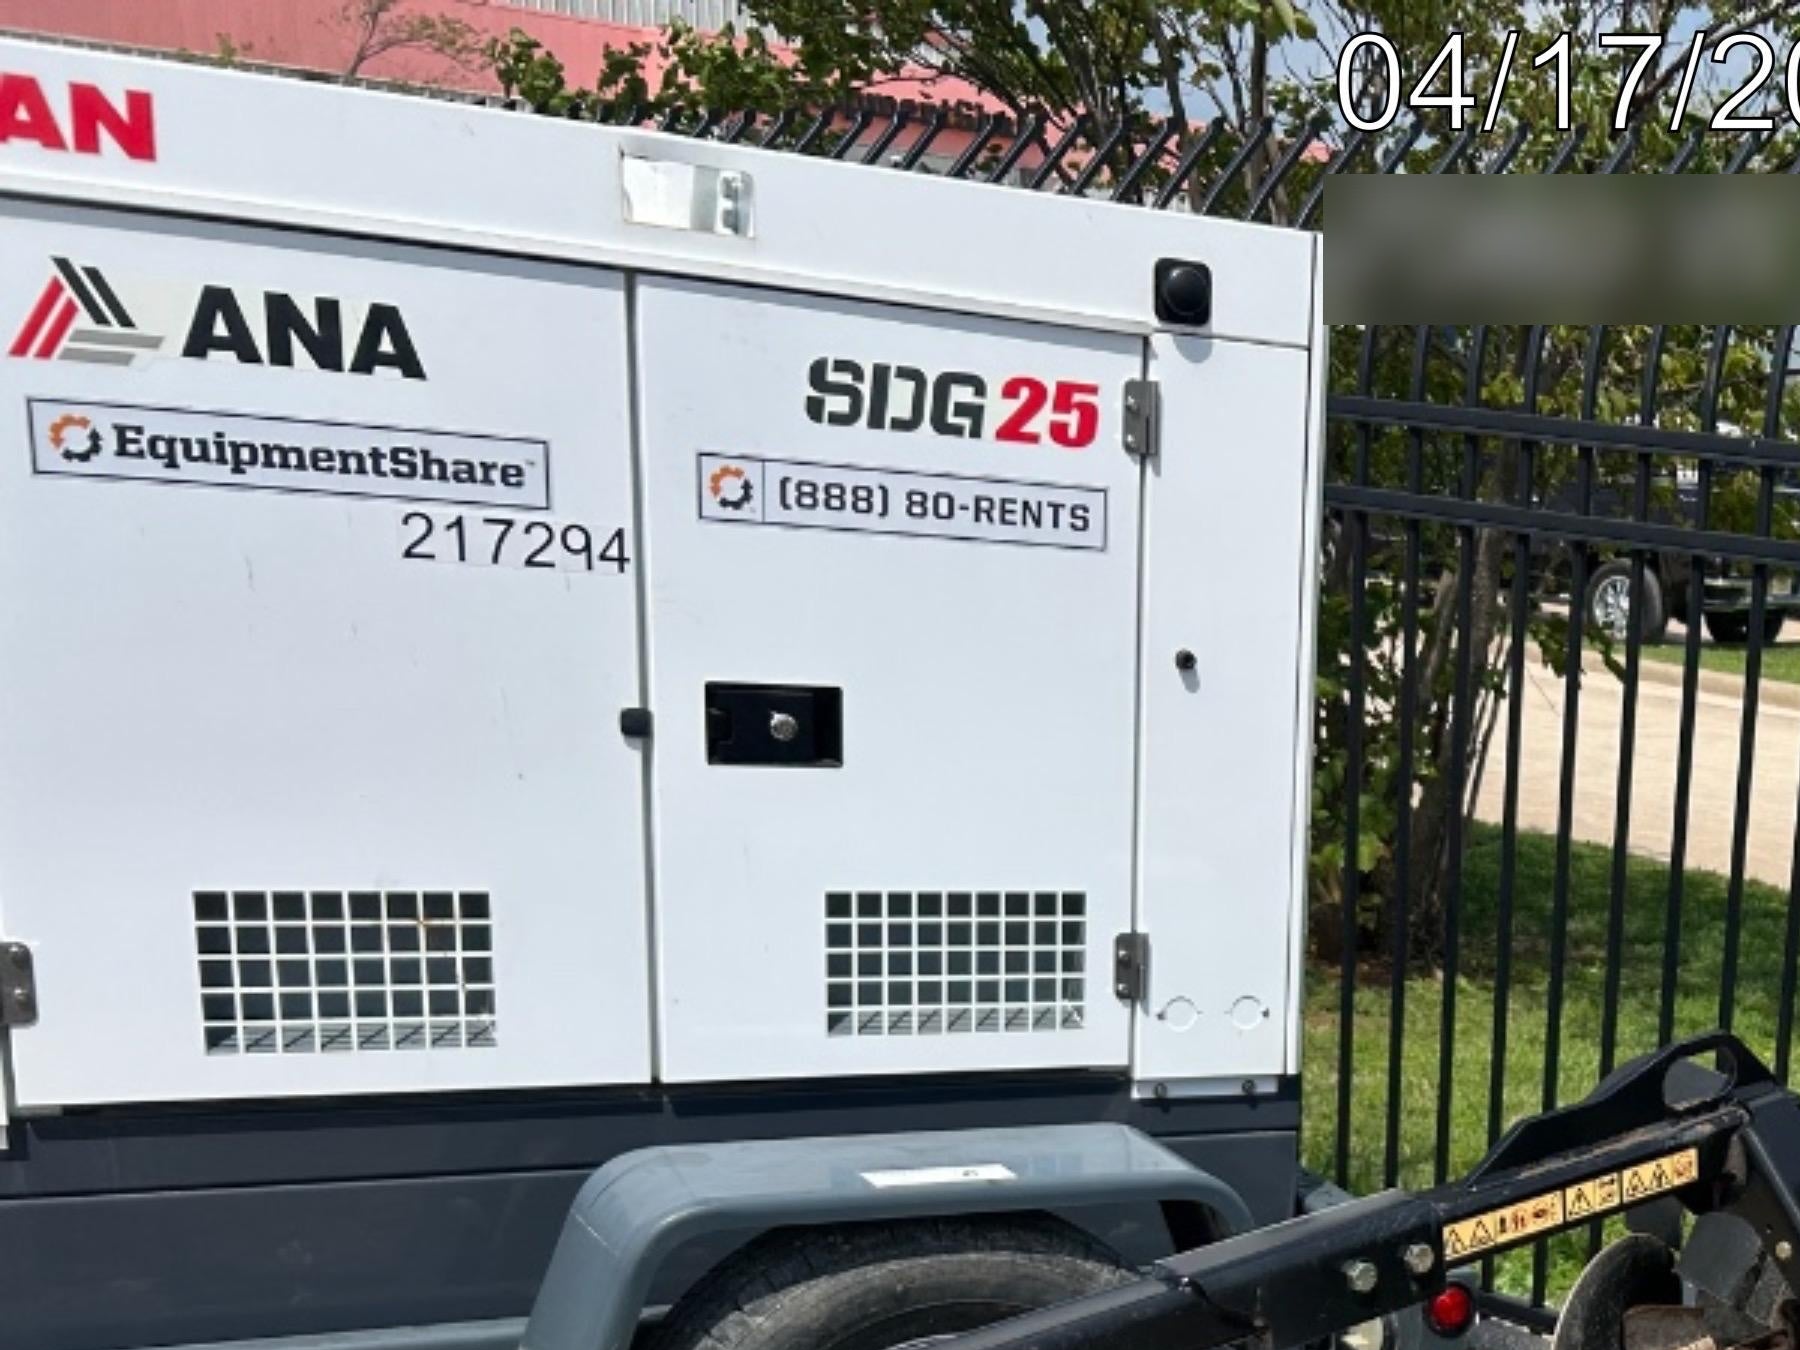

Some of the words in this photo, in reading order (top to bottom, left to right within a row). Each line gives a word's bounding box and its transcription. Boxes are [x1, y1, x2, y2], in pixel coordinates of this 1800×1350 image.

[181, 284, 427, 380] ANA
[111, 423, 526, 490] EquipmentShare
[778, 476, 888, 518] (888)
[905, 489, 1091, 533] 80-RENTS
[402, 512, 630, 573] 217294
